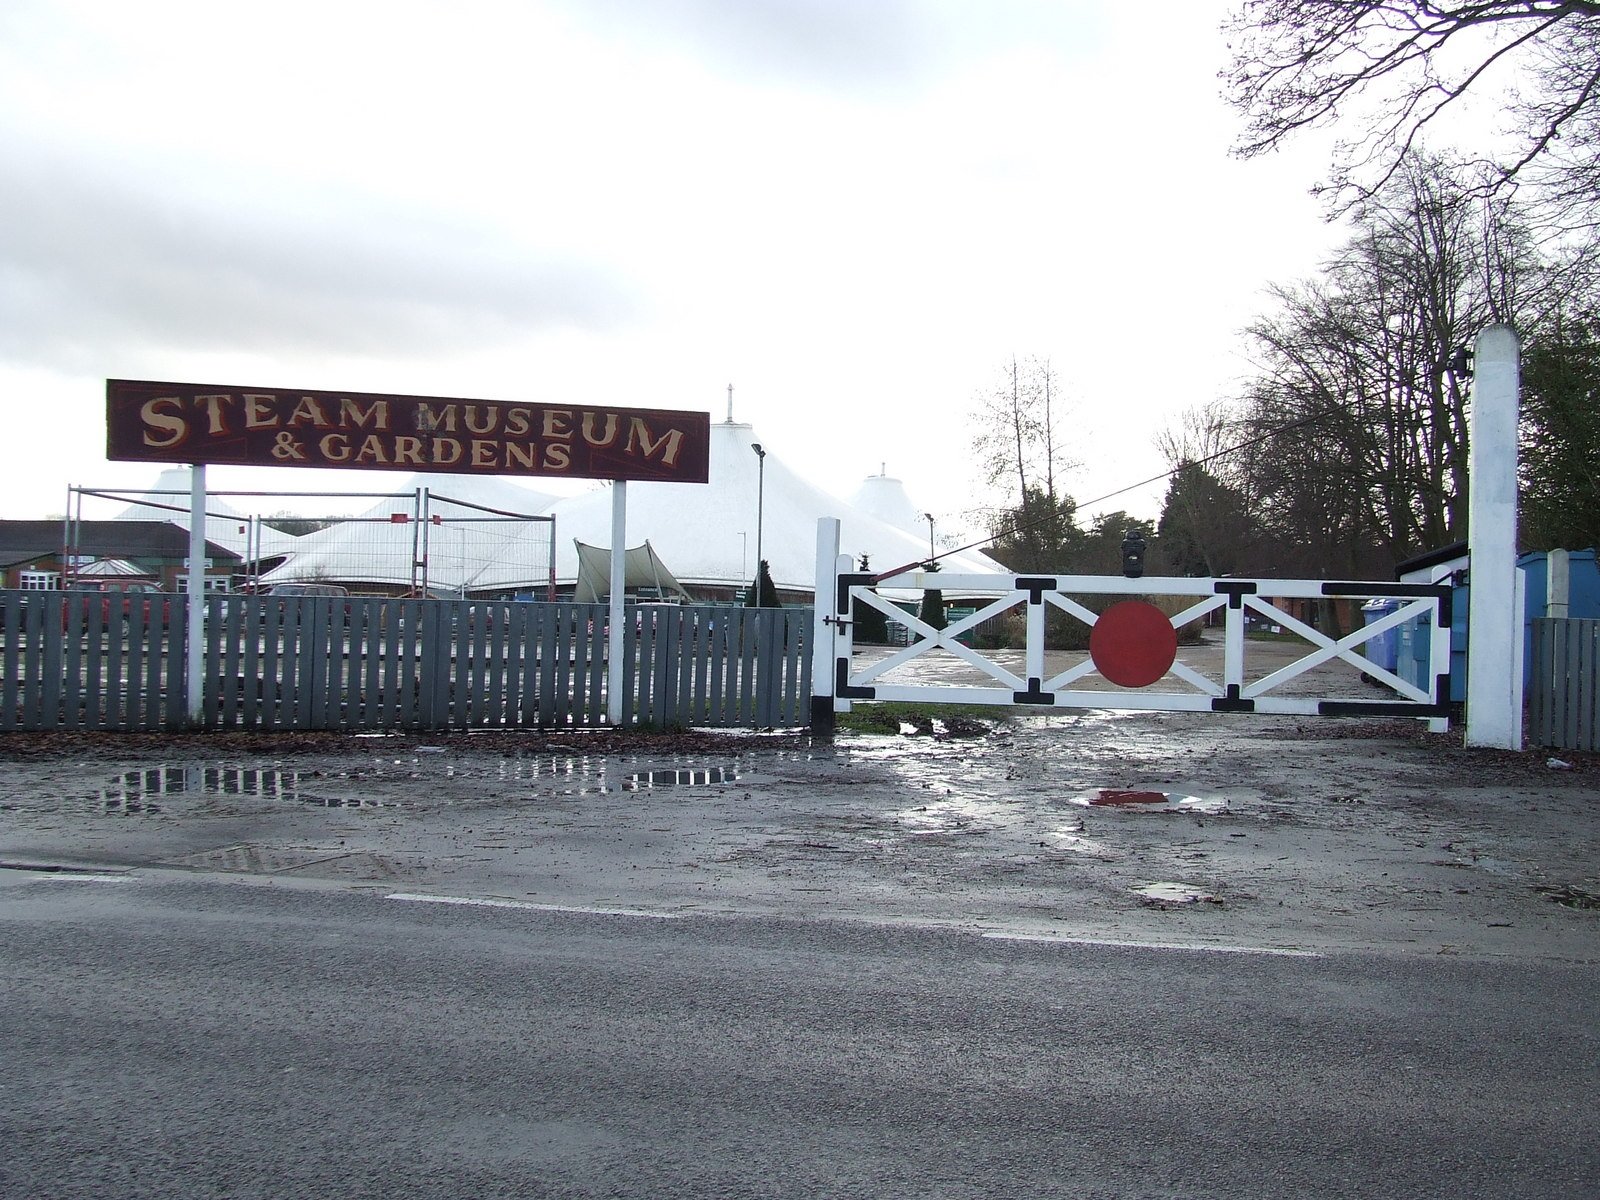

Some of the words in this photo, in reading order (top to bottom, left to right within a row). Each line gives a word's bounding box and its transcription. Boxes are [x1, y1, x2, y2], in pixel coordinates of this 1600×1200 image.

[140, 394, 388, 447] STEAM
[417, 402, 684, 465] MUSEUM
[271, 431, 305, 459] &
[319, 433, 571, 469] GARDENS
